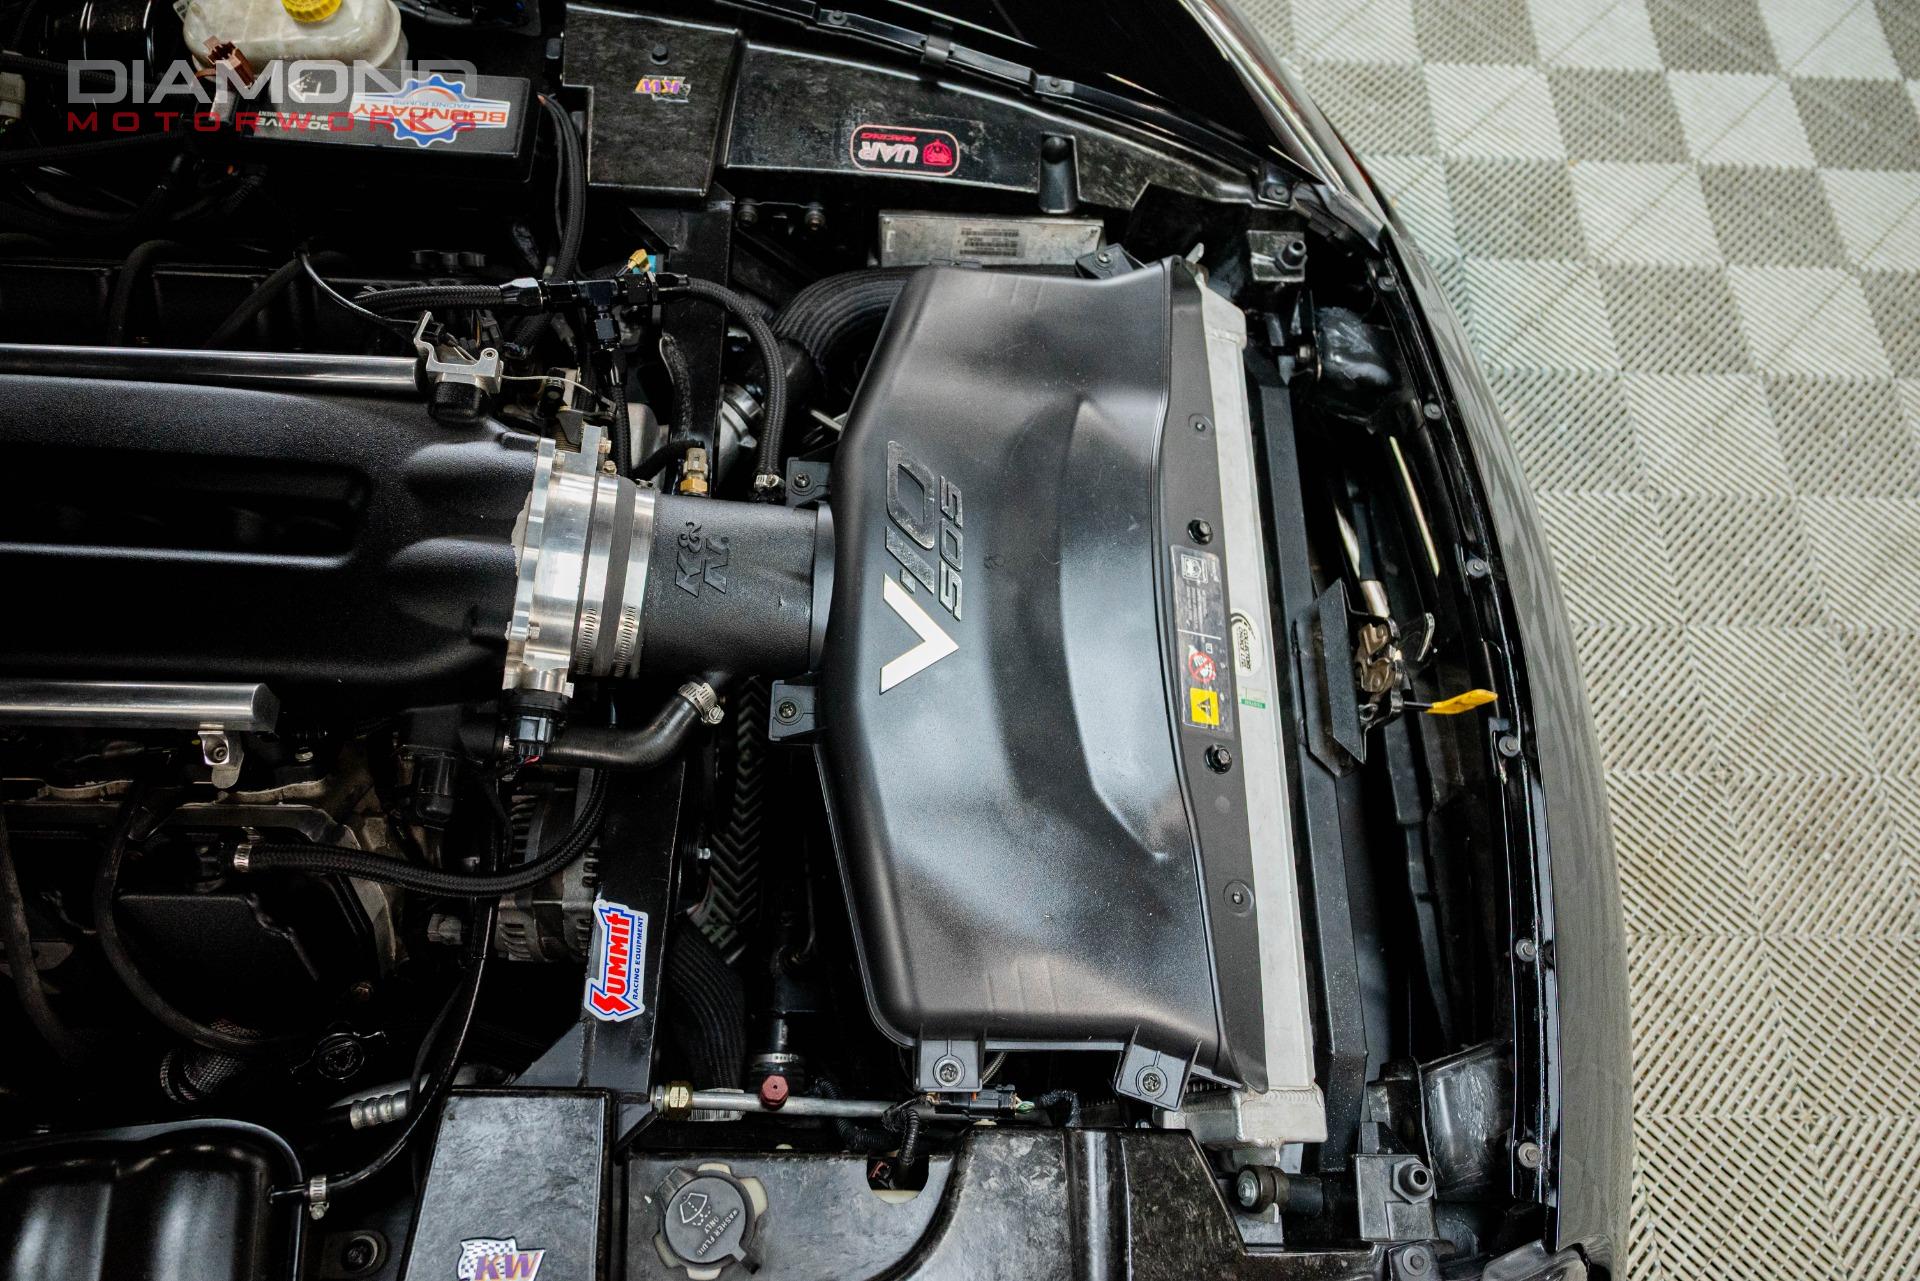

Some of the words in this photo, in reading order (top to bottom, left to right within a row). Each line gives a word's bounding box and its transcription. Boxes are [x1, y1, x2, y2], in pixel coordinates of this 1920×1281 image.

[353, 103, 507, 123] BOUNDARY
[860, 132, 917, 142] RACING
[858, 141, 918, 164] UAR
[938, 476, 964, 622] 505
[634, 916, 643, 965] EQUIPMENT
[593, 913, 631, 1013] SUMMIT
[632, 967, 640, 1000] RACING
[704, 1216, 719, 1234] ONLY
[713, 1209, 739, 1236] WASHER
[696, 1236, 716, 1256] FLUID
[475, 1253, 540, 1280] KW
